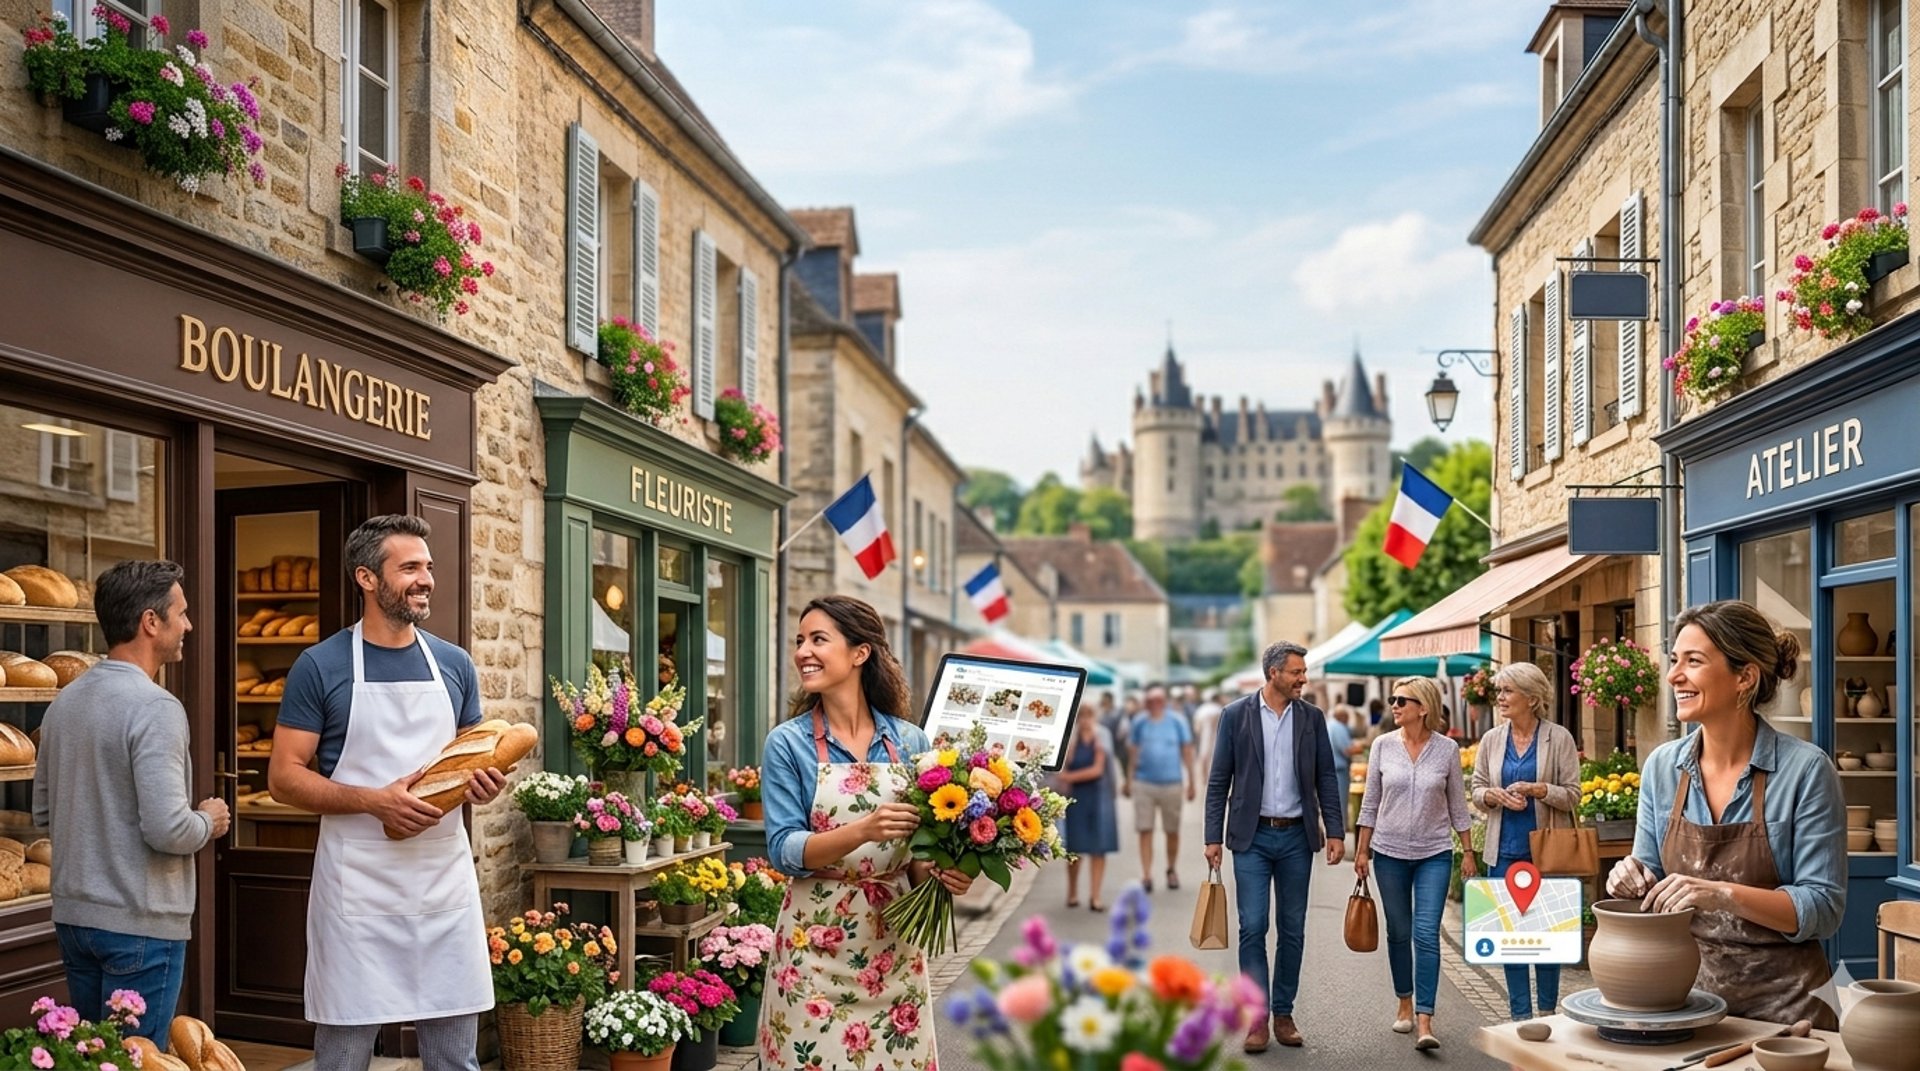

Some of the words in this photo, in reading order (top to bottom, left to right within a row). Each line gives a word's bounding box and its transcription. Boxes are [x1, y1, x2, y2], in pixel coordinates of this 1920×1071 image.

[179, 314, 432, 441] BOULANGERIE
[1746, 417, 1864, 499] ATELIER
[631, 465, 733, 534] FLEURISTE
